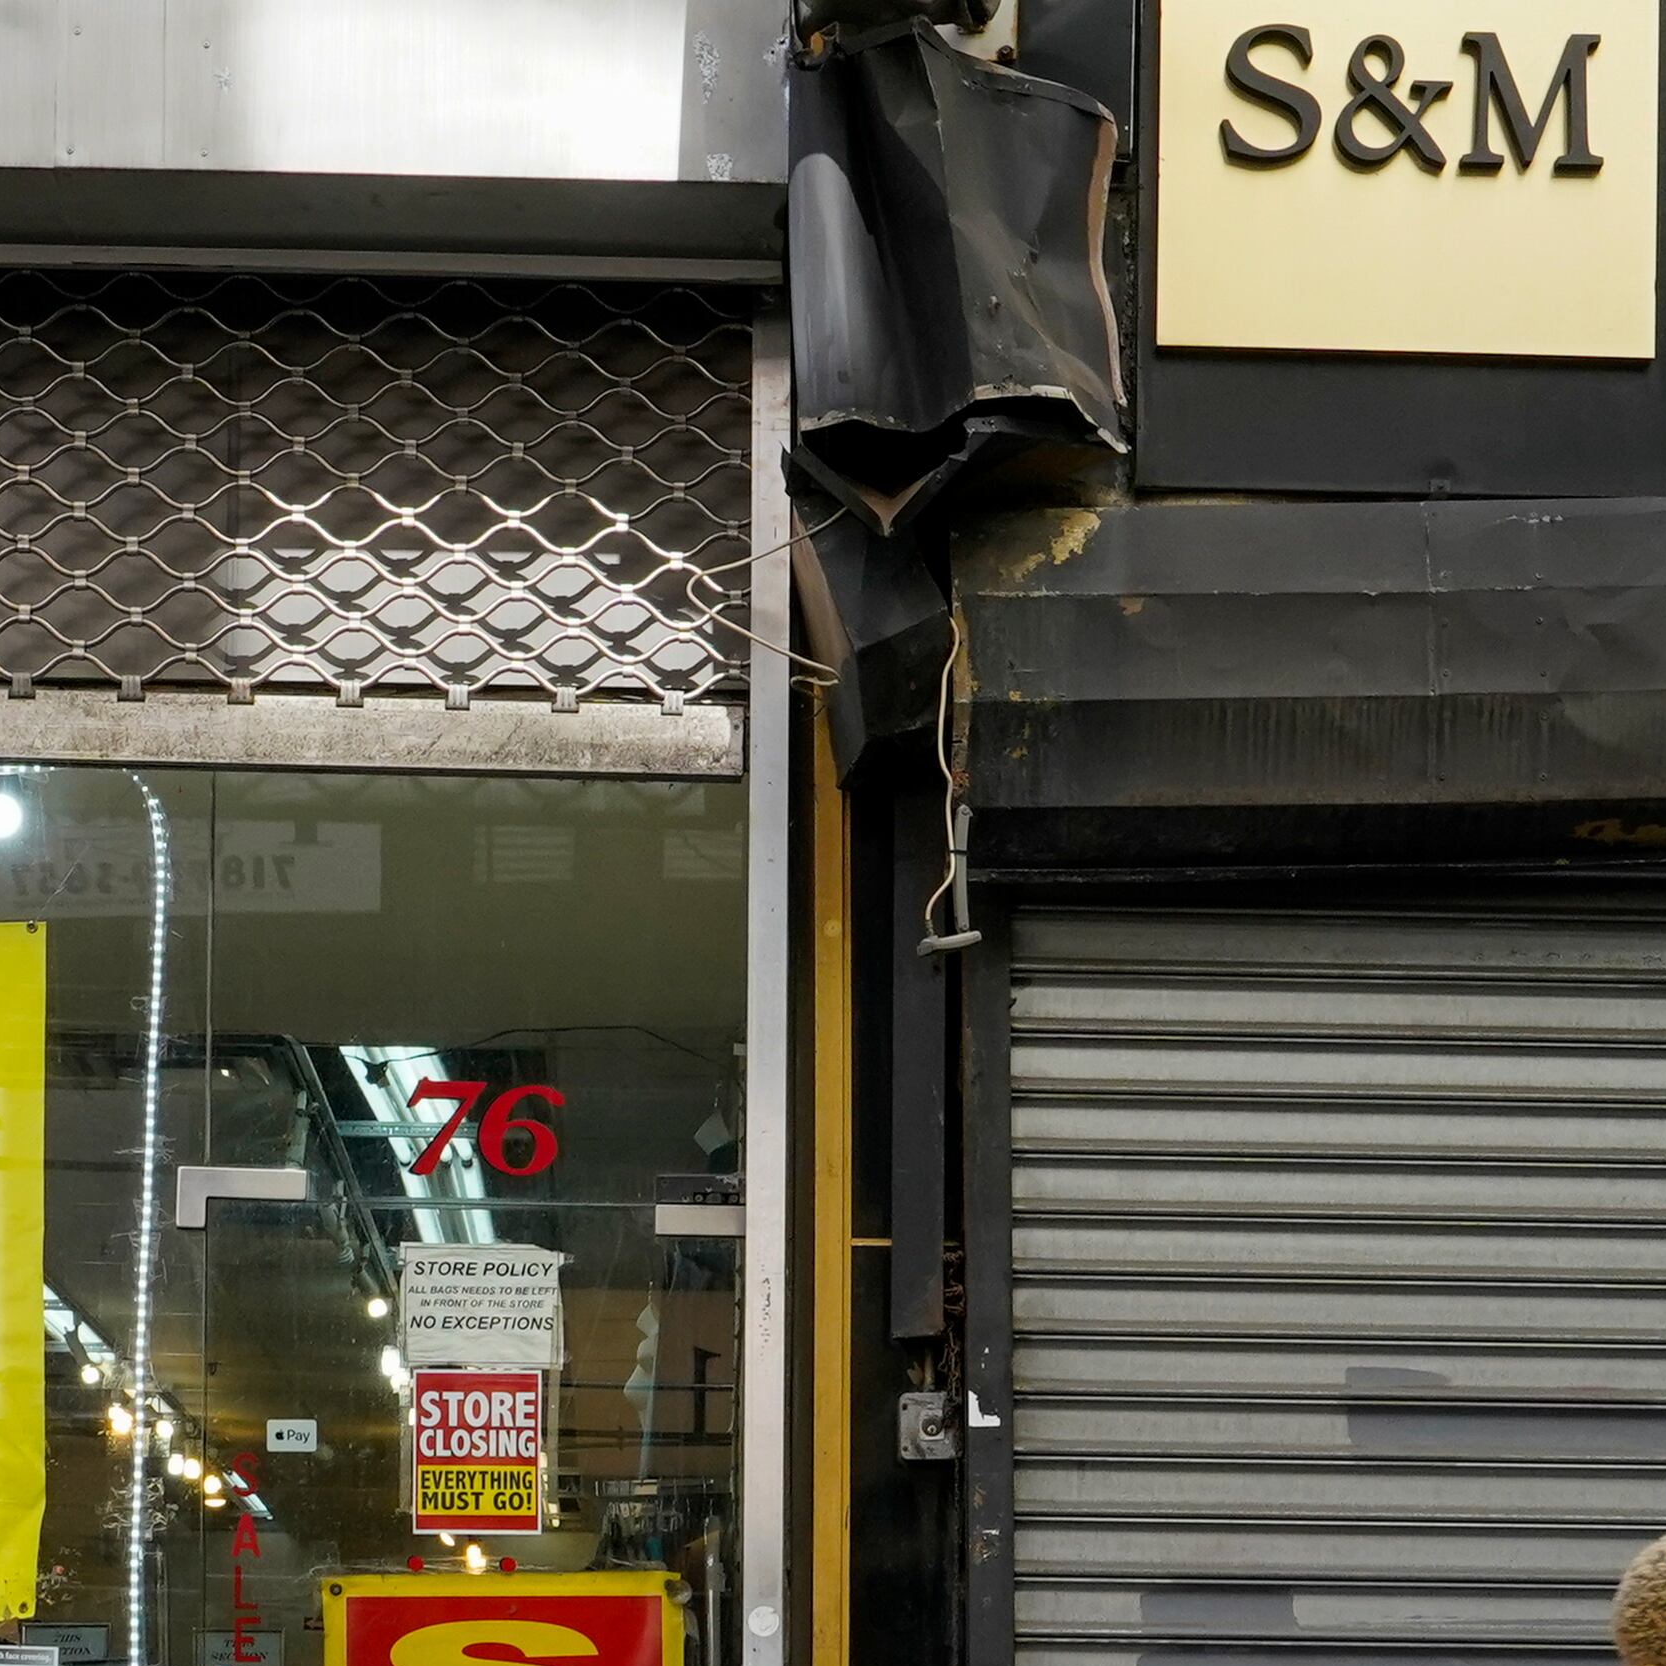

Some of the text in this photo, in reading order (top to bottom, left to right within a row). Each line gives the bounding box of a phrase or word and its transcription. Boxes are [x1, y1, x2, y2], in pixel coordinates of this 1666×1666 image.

[1219, 23, 1604, 177] S&M
[406, 1079, 566, 1177] 76
[414, 1261, 553, 1277] STORE POLICY
[408, 1286, 558, 1296] ALL BAGS NEEDS TO BE LEFT
[420, 1299, 545, 1309] IN FRONT OF THE STORE
[410, 1316, 555, 1331] NO EXCEPTIONS
[420, 1391, 536, 1428] STORE
[287, 1429, 310, 1443] Pay
[419, 1429, 536, 1458] CLOSING
[421, 1470, 533, 1490] EVERYTHING
[422, 1492, 532, 1511] MUST GO!
[232, 1452, 262, 1663] SALE
